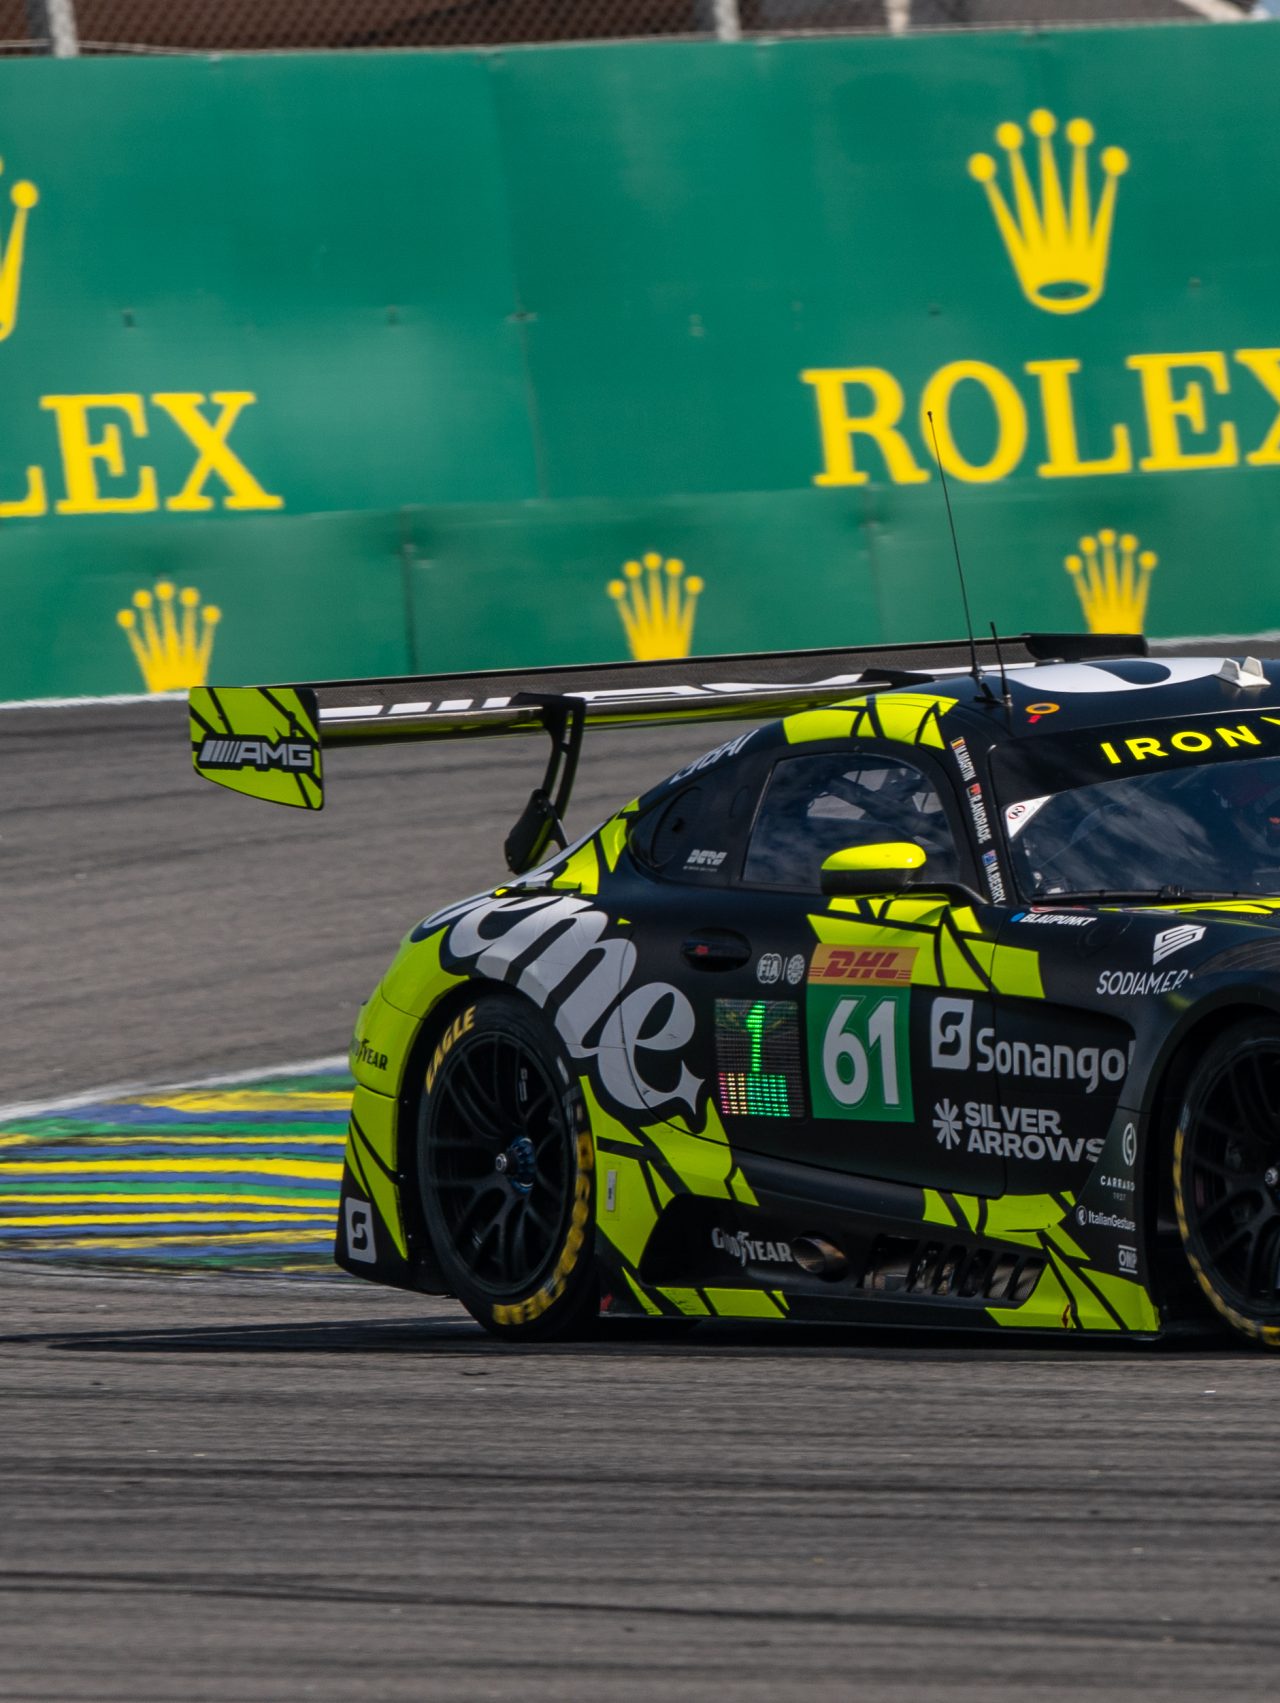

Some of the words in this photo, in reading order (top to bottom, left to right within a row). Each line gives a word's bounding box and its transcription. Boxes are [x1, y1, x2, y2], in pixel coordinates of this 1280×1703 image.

[235, 743, 312, 767] AMG
[1101, 726, 1261, 765] IRON
[1022, 912, 1098, 927] BLAUPUNKT
[822, 950, 899, 979] DHL
[426, 1005, 476, 1095] EAGLE
[822, 1000, 901, 1106] 61
[964, 1102, 1062, 1136] SILVER
[967, 1127, 1106, 1163] ARROWS
[712, 1228, 795, 1267] GOODYEAR
